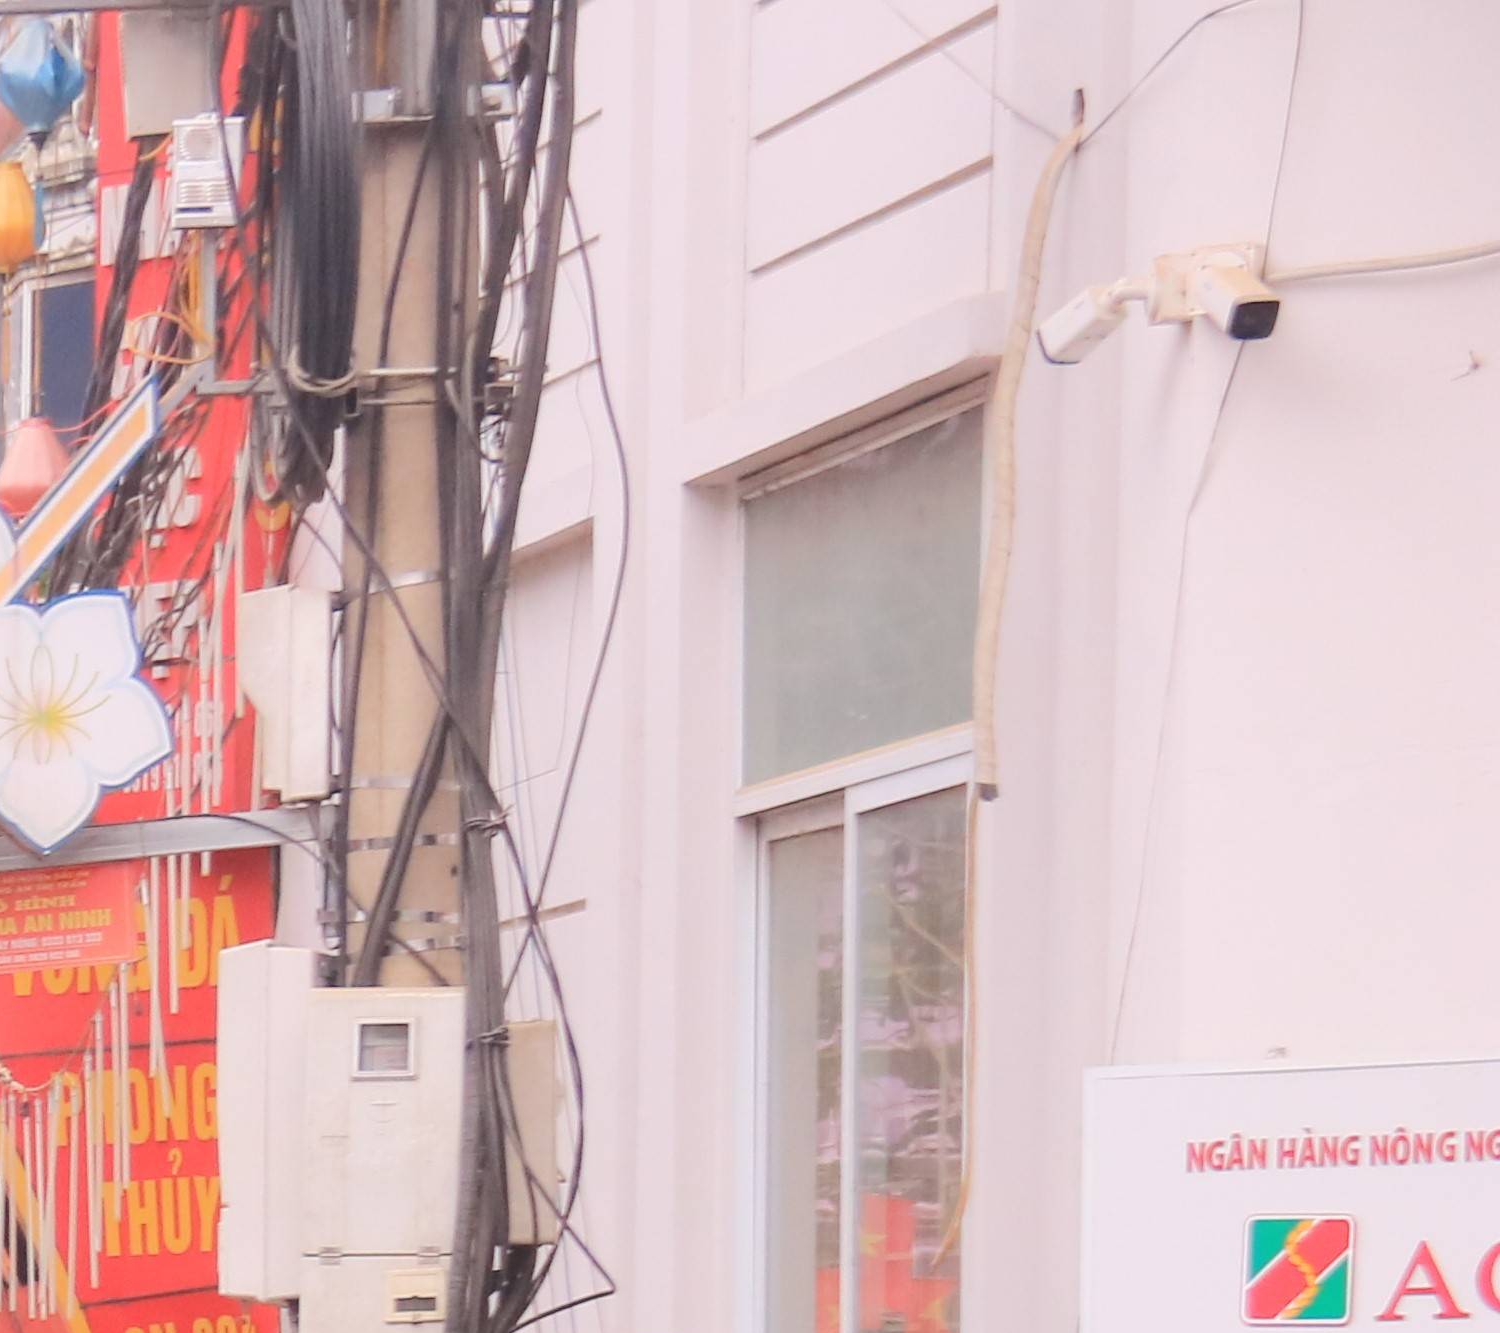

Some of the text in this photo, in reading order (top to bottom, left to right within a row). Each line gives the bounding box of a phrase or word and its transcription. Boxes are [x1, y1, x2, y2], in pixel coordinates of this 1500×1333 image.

[23, 913, 53, 933] AN
[59, 908, 112, 930] NINH
[1185, 1132, 1269, 1173] NGÂN
[1275, 1127, 1362, 1169] HÀNG
[1368, 1126, 1457, 1167] NÔNG
[101, 1148, 221, 1259] THỦY
[1372, 1239, 1500, 1322] A
